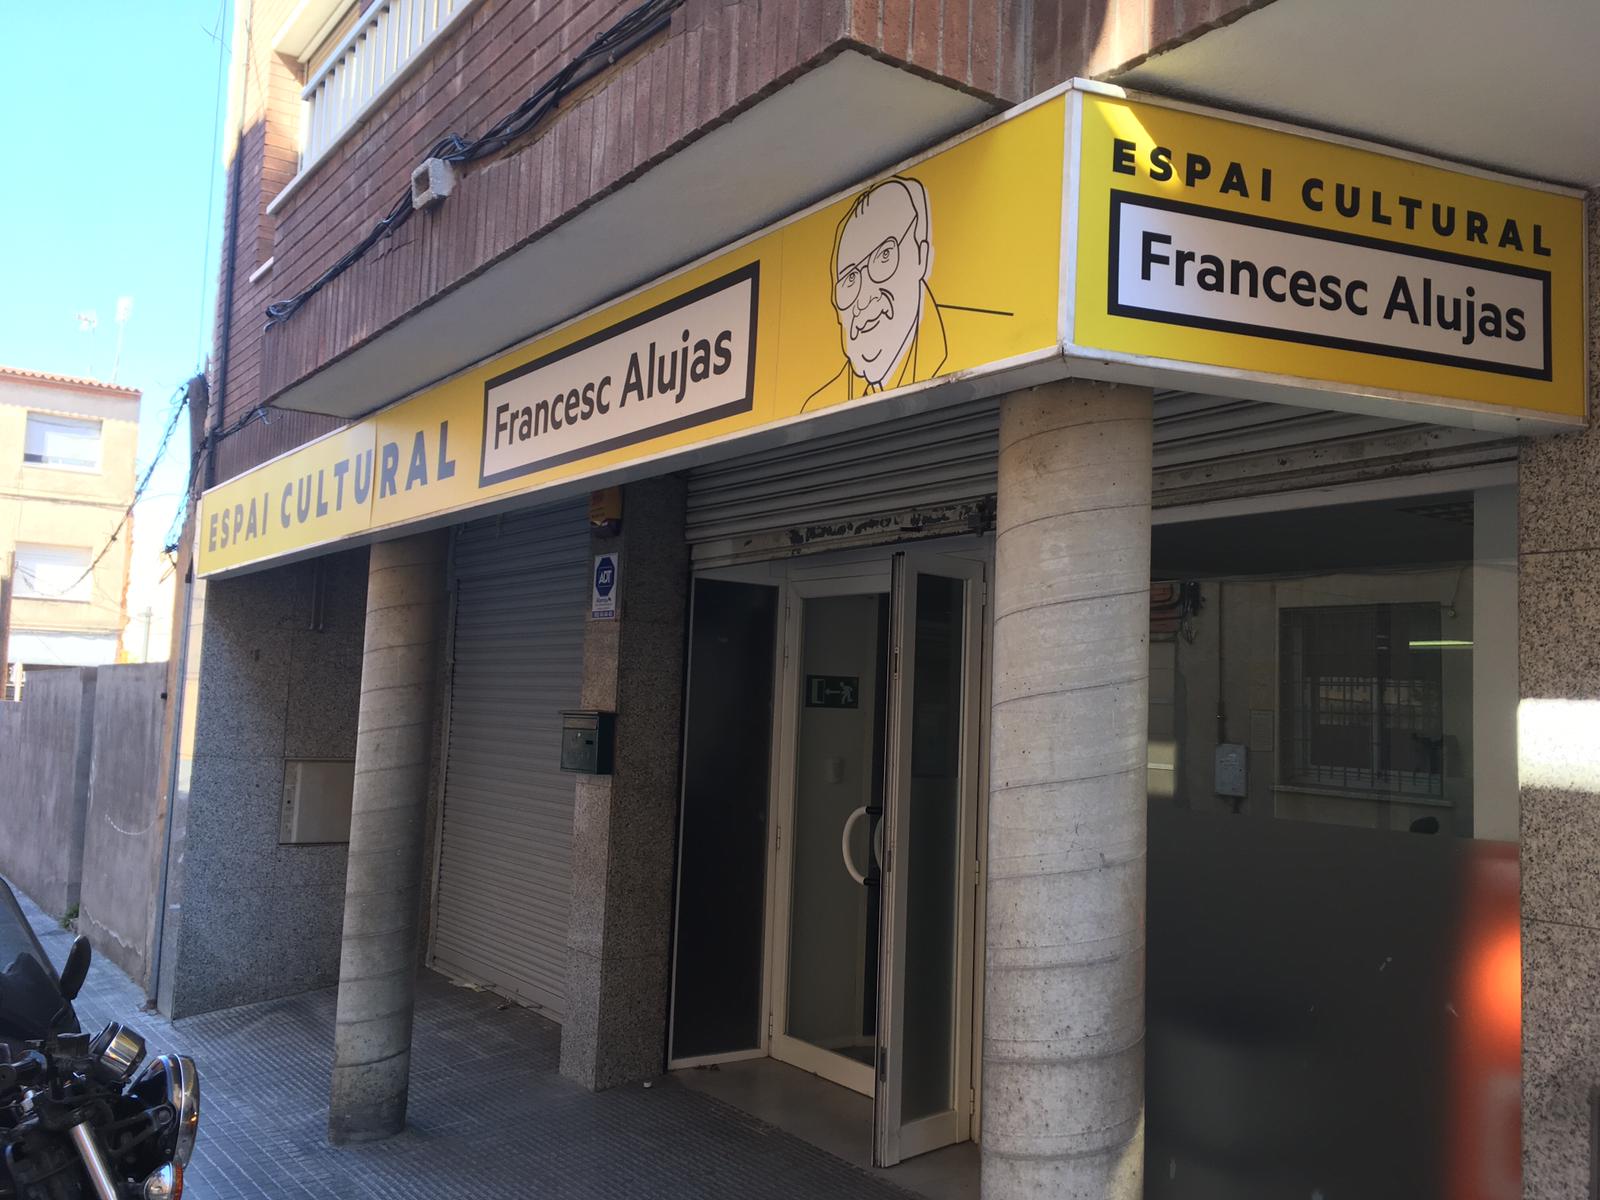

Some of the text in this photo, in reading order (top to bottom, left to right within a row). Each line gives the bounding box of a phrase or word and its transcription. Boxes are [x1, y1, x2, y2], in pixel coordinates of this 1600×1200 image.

[1112, 138, 1552, 257] ESPAI CULTURAL
[1140, 230, 1527, 345] Francesc Alujas
[494, 328, 732, 450] Francesc Alujas
[208, 420, 456, 553] ESPAI CULTURAL
[599, 570, 612, 584] ADT
